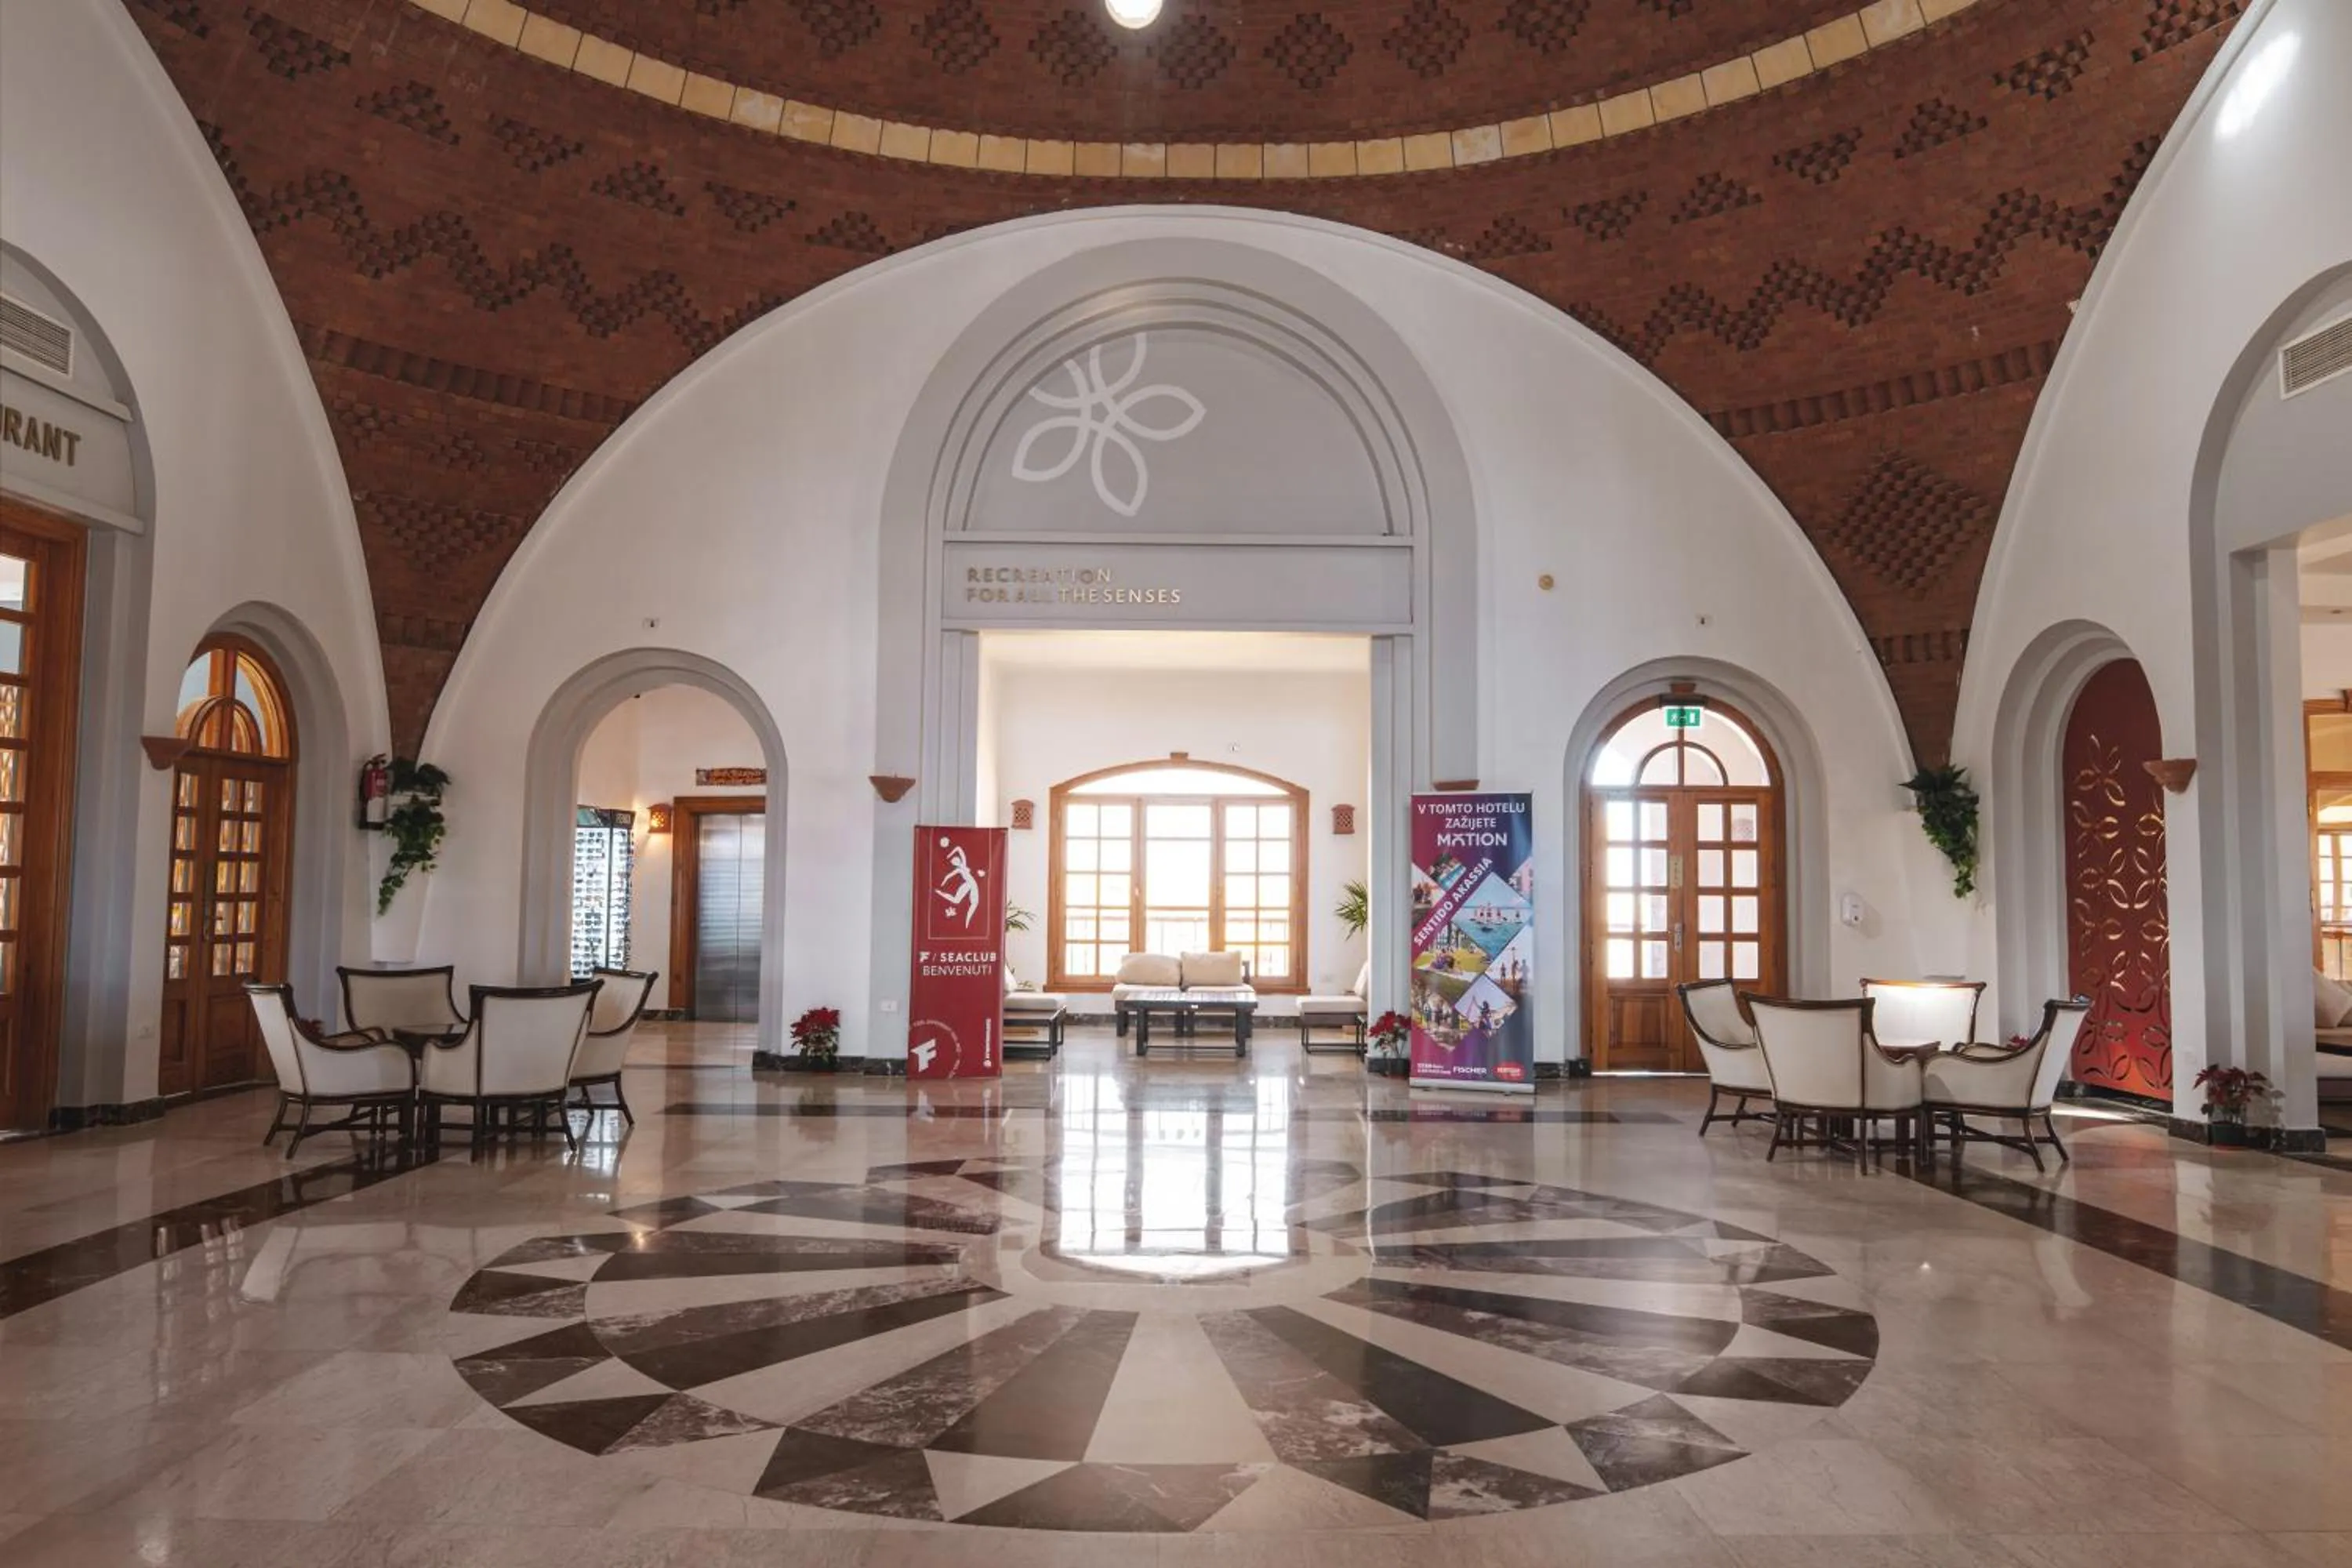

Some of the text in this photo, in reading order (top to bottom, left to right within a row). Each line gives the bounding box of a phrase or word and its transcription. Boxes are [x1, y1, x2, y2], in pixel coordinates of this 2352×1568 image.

[967, 567, 1112, 583] RECREATION
[967, 588, 1009, 603] FOR
[1102, 589, 1181, 603] SENSES
[1417, 802, 1525, 815] V TOMTO HOTELU
[1445, 815, 1497, 829] ZAŽIJETE
[1414, 857, 1494, 947] SENTIDO AKASSIA
[940, 952, 996, 963] SEACLUB
[923, 964, 992, 976] BENVENUTI
[1453, 1065, 1487, 1075] FISCHER
